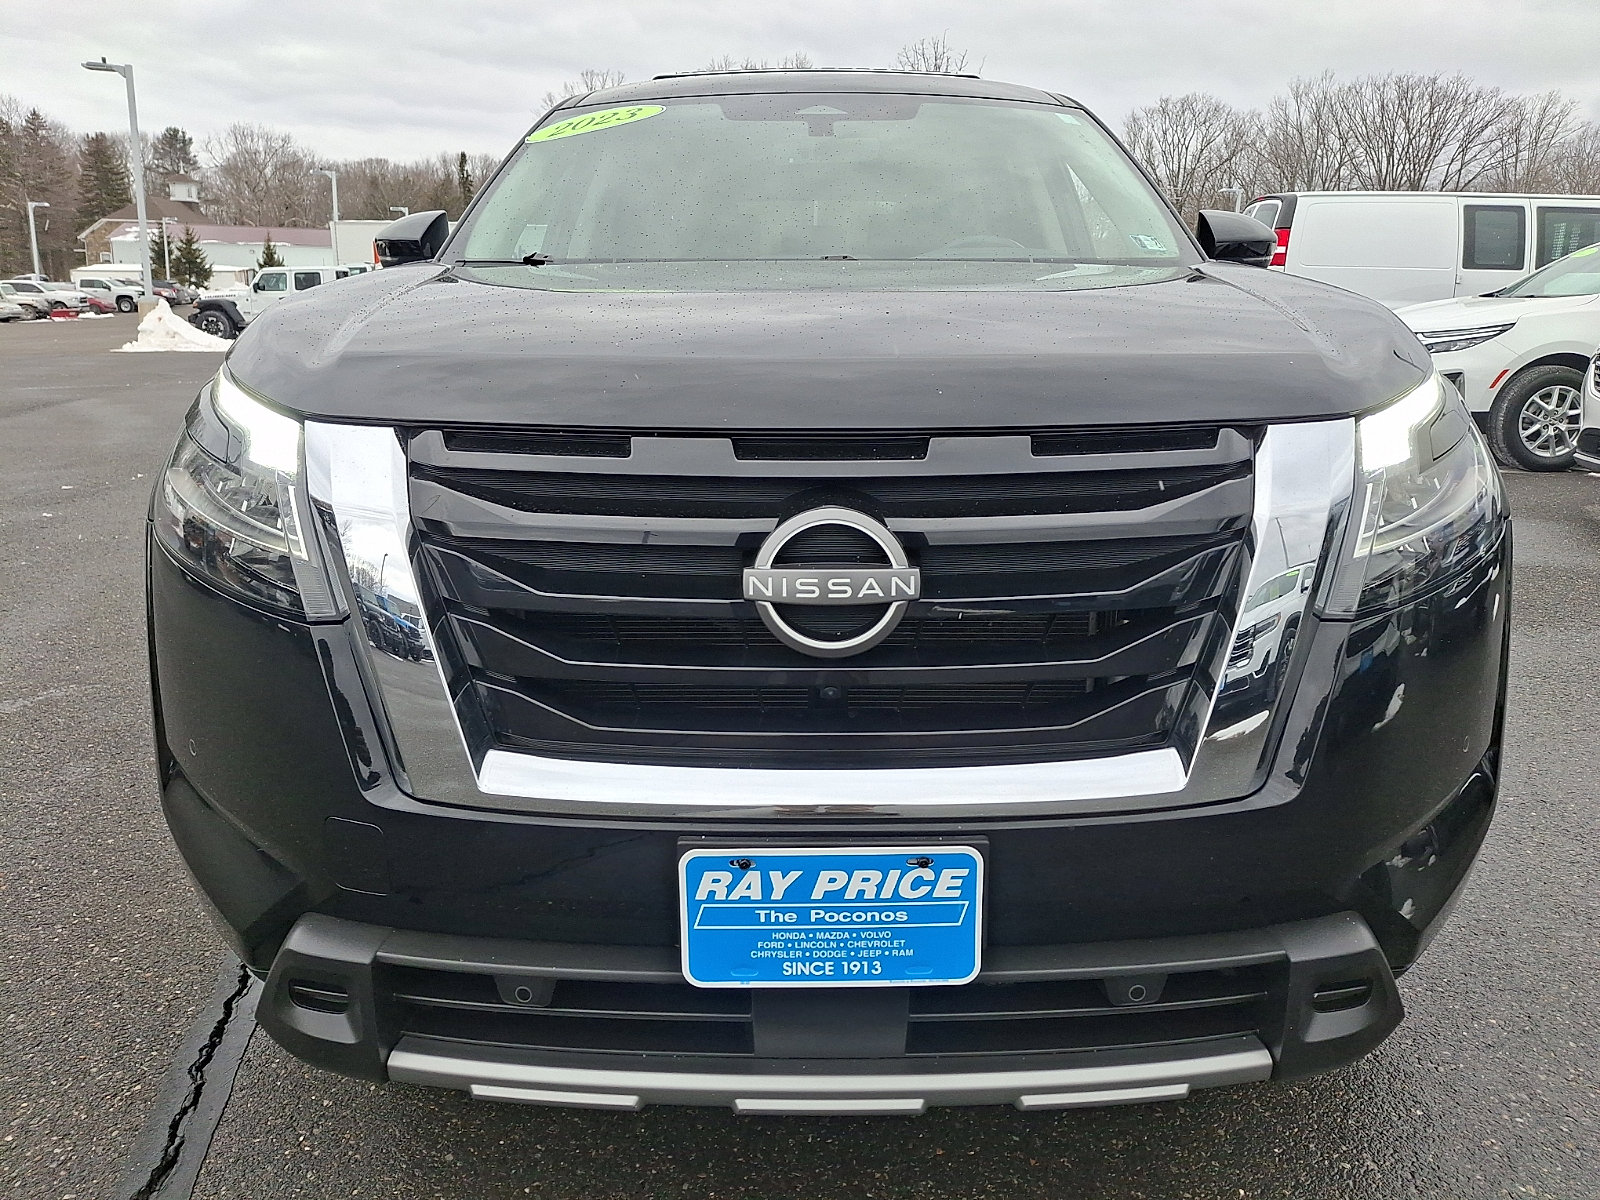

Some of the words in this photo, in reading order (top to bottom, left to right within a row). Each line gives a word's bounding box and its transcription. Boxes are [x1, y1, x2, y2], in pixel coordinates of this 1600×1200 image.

[547, 108, 643, 138] 2023
[749, 575, 915, 598] NISSAN
[695, 870, 803, 900] RAY
[811, 868, 970, 900] PRICE
[755, 910, 797, 923] The
[810, 909, 908, 923] Poconos
[772, 932, 806, 940] HONDA
[816, 932, 850, 940] MAZDA
[860, 931, 892, 939] VOLVO
[757, 941, 785, 949] FORD
[794, 941, 837, 949] LINCOLN
[847, 940, 906, 948] CHEVROLET
[812, 950, 847, 958] DODGE
[892, 949, 914, 957] RAM
[782, 961, 835, 976] SINCE
[841, 961, 882, 975] 1913
